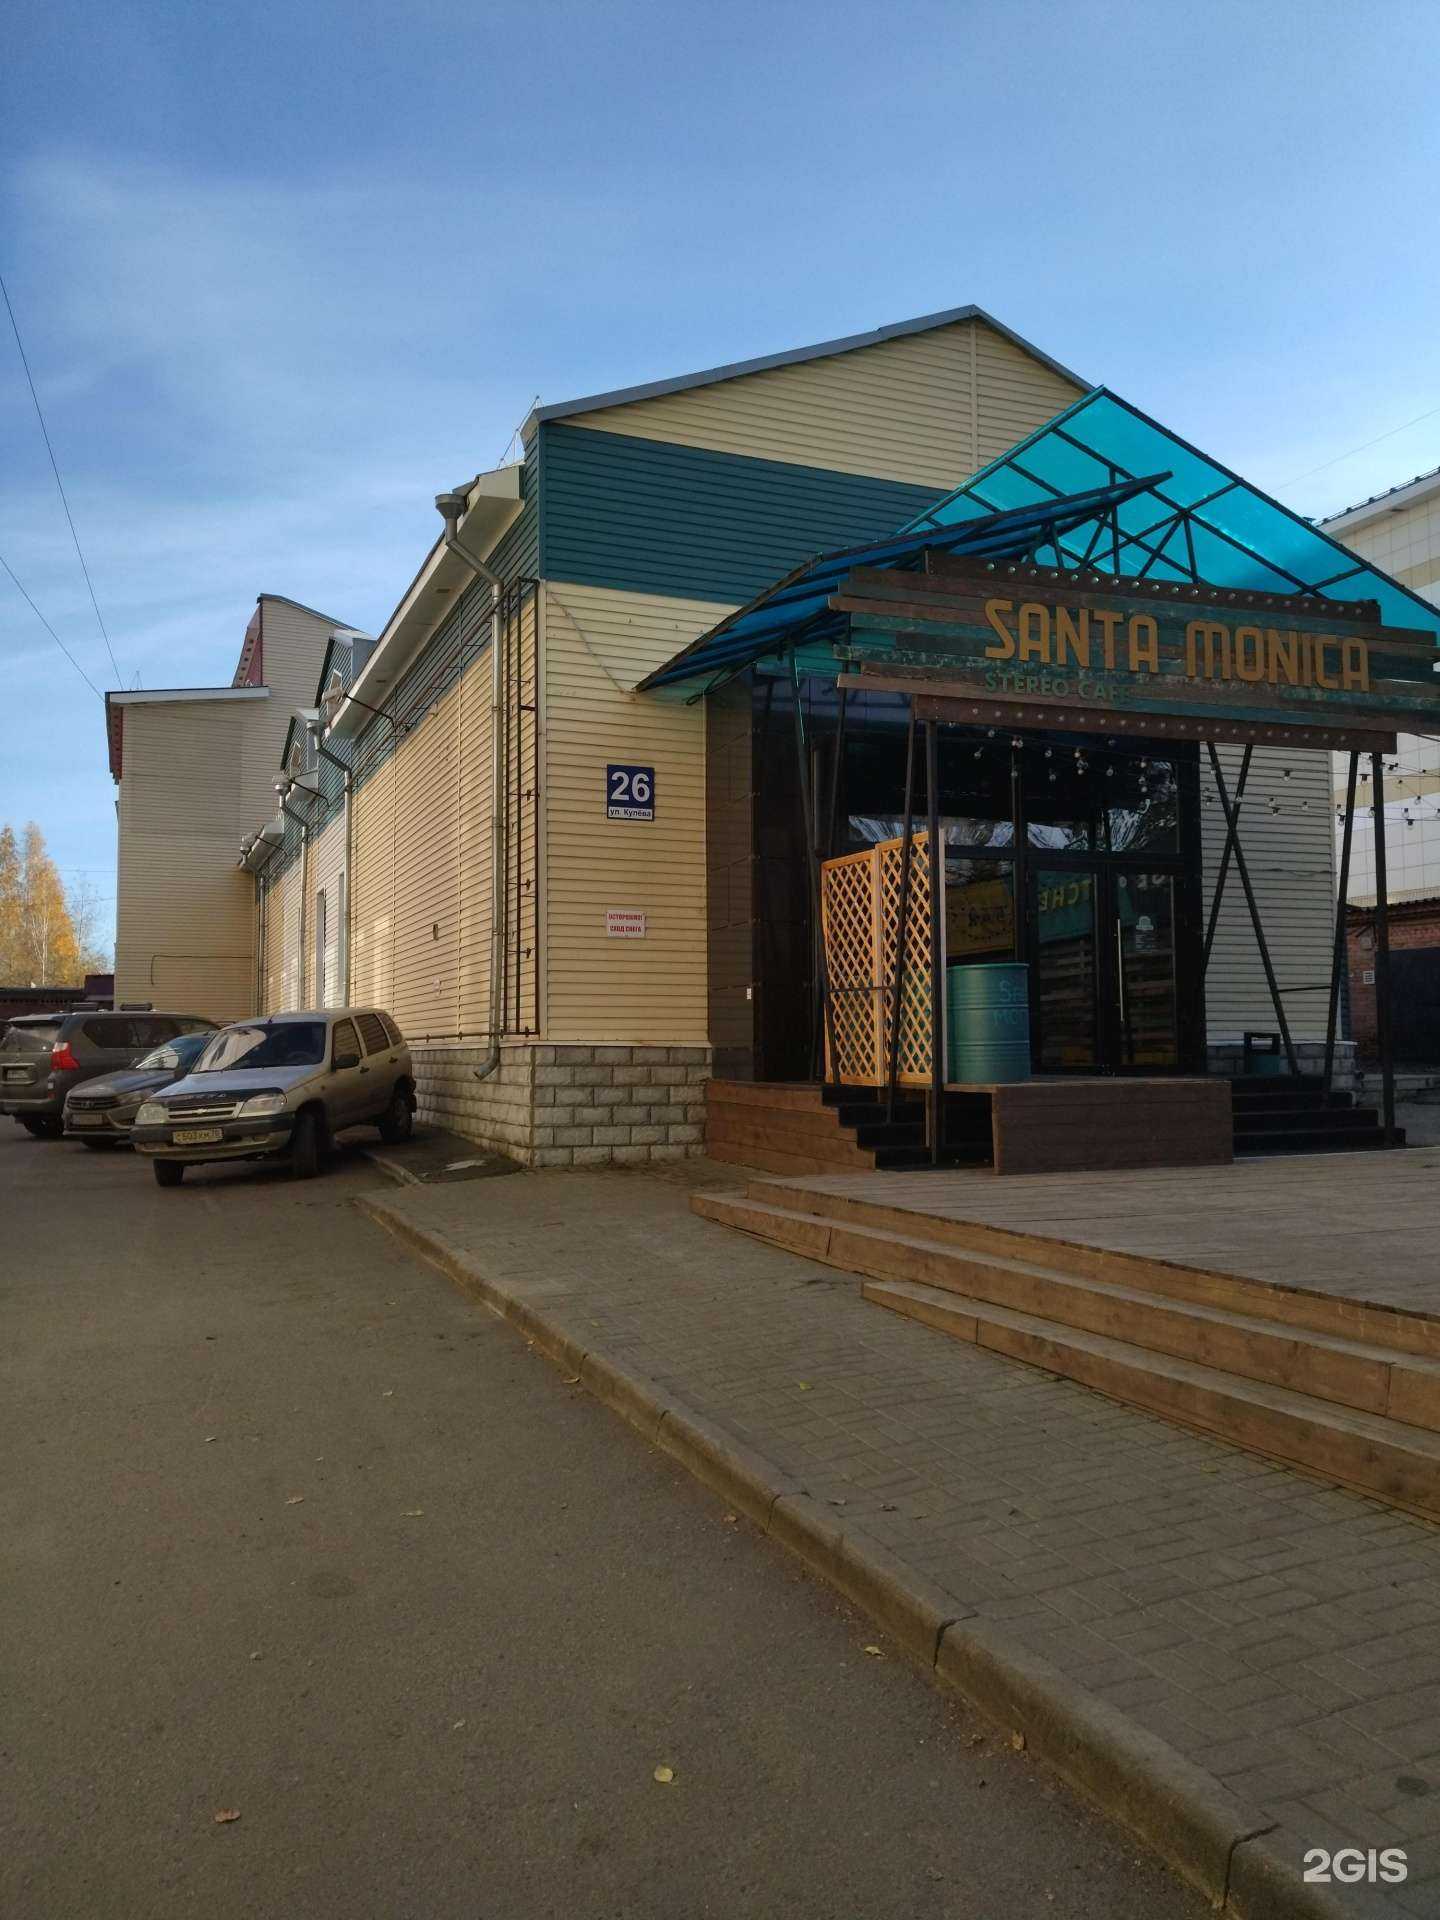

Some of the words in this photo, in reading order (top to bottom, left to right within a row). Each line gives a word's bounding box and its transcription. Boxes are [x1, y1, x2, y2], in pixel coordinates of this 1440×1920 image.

[984, 598, 1159, 673] SANTA
[1185, 619, 1370, 692] MONICA
[984, 671, 1069, 698] STEREO
[610, 771, 650, 802] 26
[623, 808, 651, 818] Кулёва
